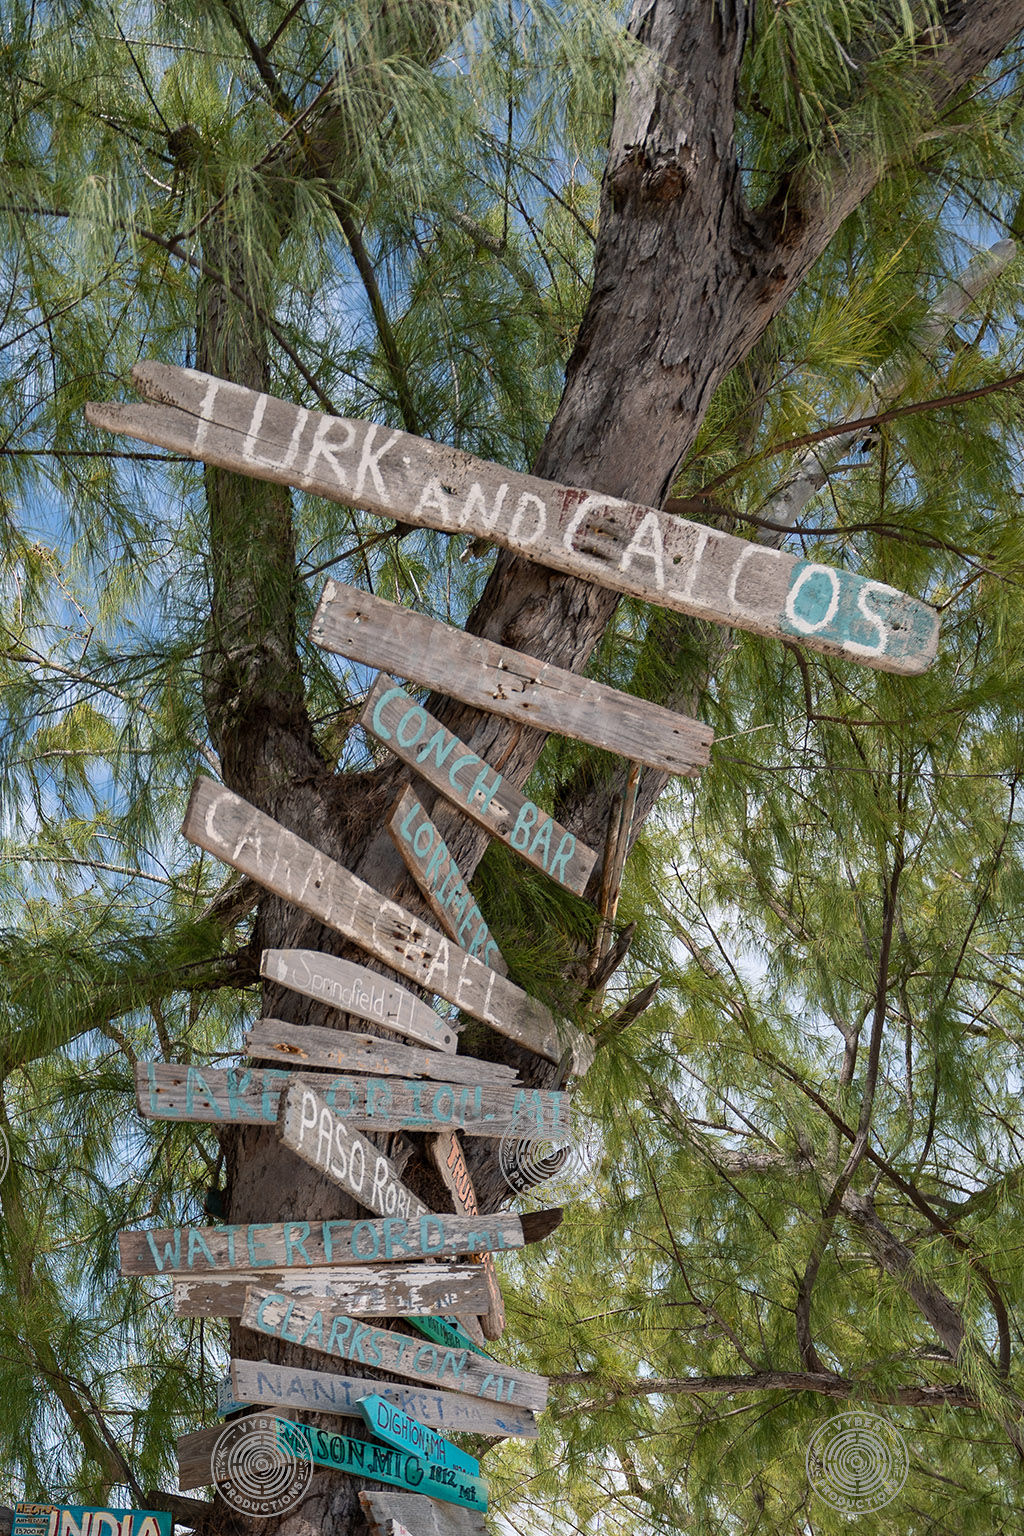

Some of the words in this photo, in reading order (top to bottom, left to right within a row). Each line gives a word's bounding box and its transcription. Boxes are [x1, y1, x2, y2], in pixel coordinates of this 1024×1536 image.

[412, 479, 546, 547] AND
[565, 496, 906, 657] CAICOS
[372, 687, 503, 815] CONCH
[511, 801, 578, 884] BAR
[146, 1062, 291, 1120] LAKE
[513, 1090, 568, 1136] MI
[297, 1092, 366, 1192] PASO
[478, 1373, 516, 1400] MI
[429, 1436, 447, 1464] MA
[429, 1465, 458, 1487] 1812
